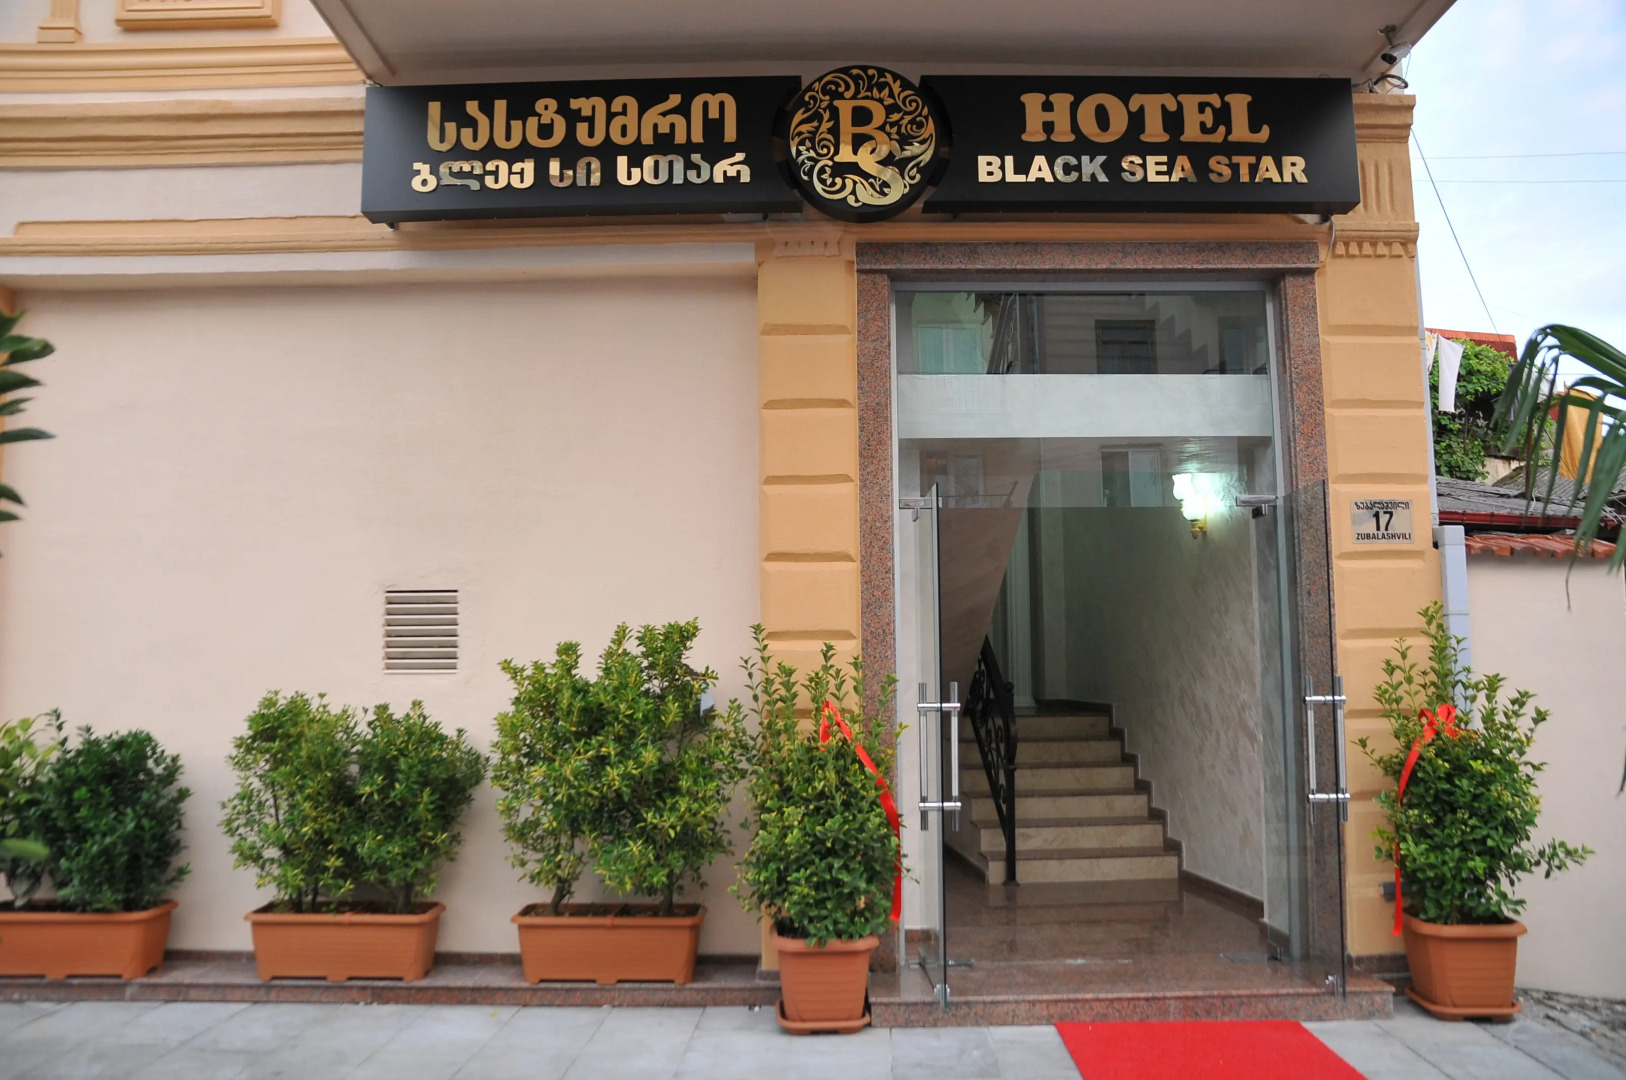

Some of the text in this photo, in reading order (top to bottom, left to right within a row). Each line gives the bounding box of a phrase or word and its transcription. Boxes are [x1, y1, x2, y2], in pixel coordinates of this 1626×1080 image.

[426, 92, 738, 152] სასტუმრო
[1020, 92, 1271, 144] HOTEL
[411, 152, 751, 193] ბლექ სი სთარ
[977, 154, 1309, 184] BLACK SEA STAR
[1356, 532, 1411, 540] ZUBALASHVILI
[1373, 511, 1393, 531] 17
